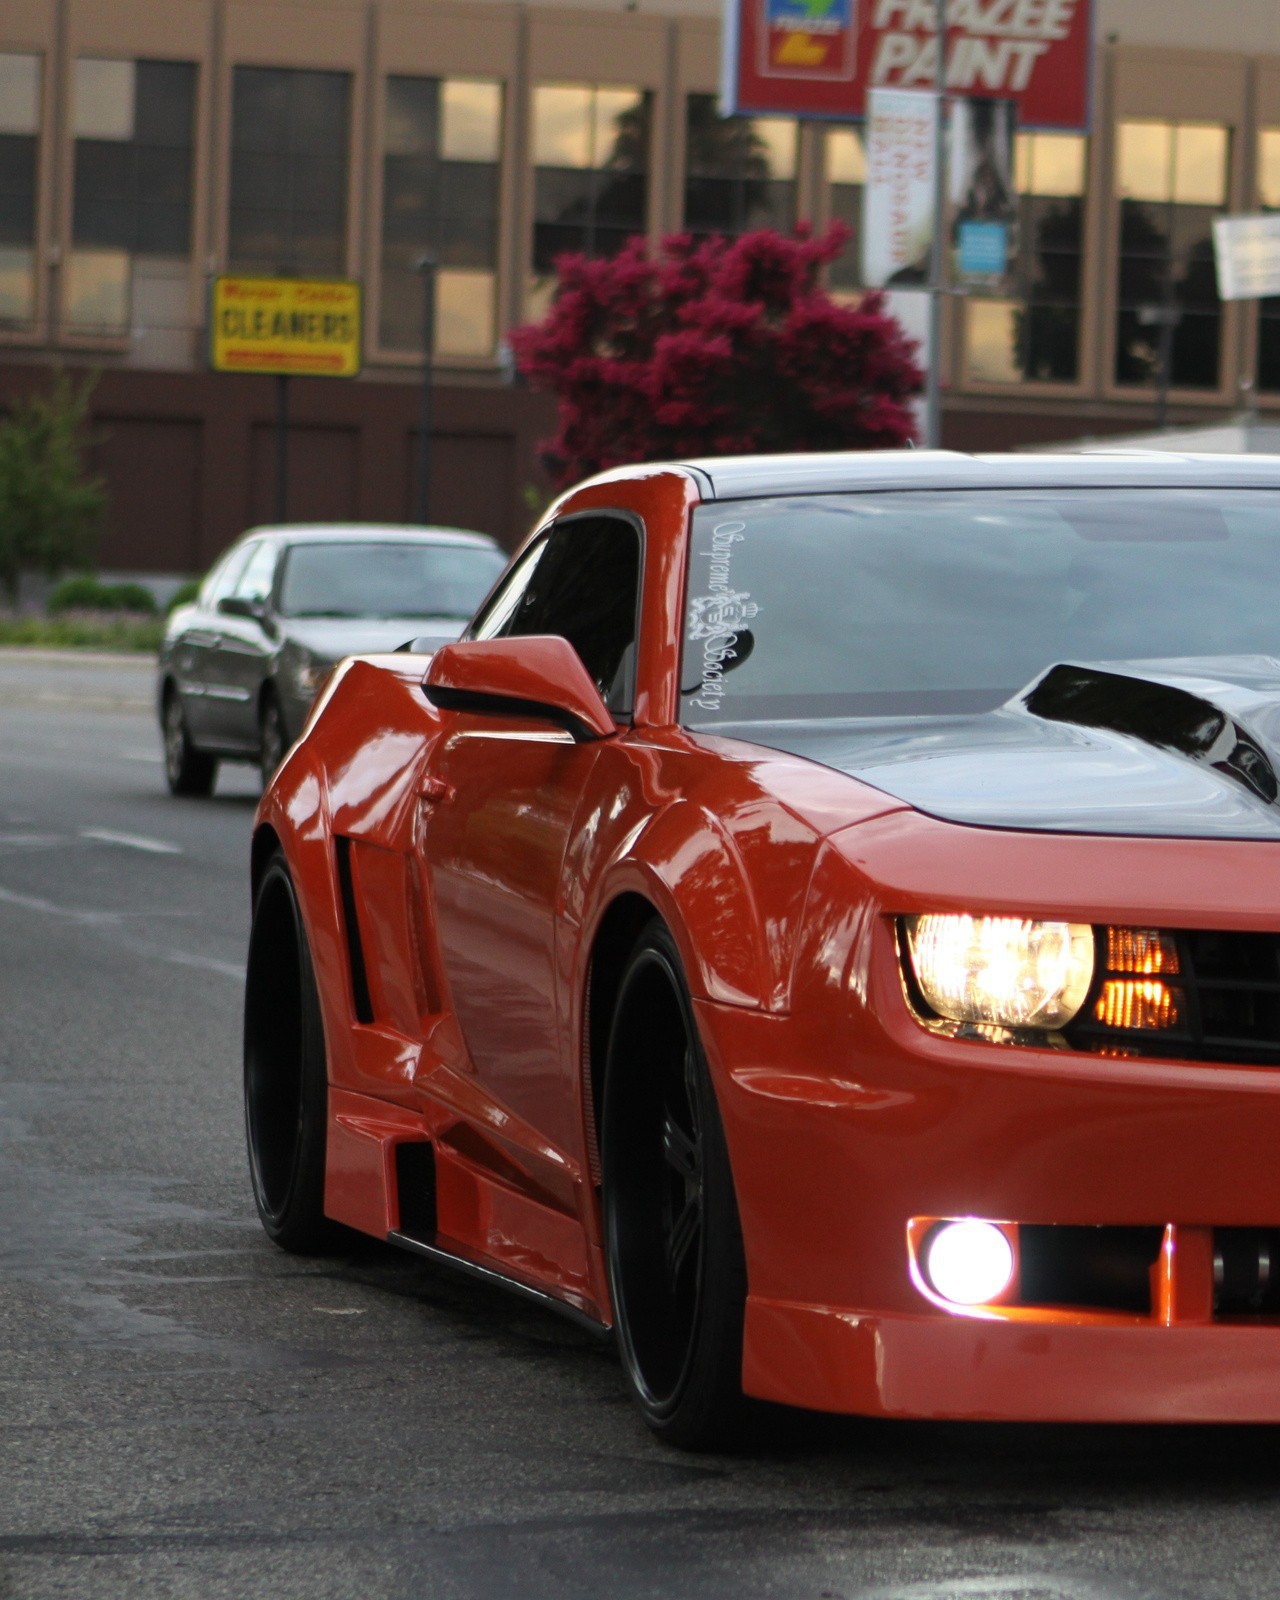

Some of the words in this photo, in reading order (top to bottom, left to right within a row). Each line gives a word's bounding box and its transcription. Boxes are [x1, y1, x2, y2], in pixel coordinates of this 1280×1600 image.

[869, 33, 1050, 91] PAINT
[222, 308, 353, 344] CLEANERS
[700, 521, 746, 594] Supreme
[690, 633, 738, 711] Society
